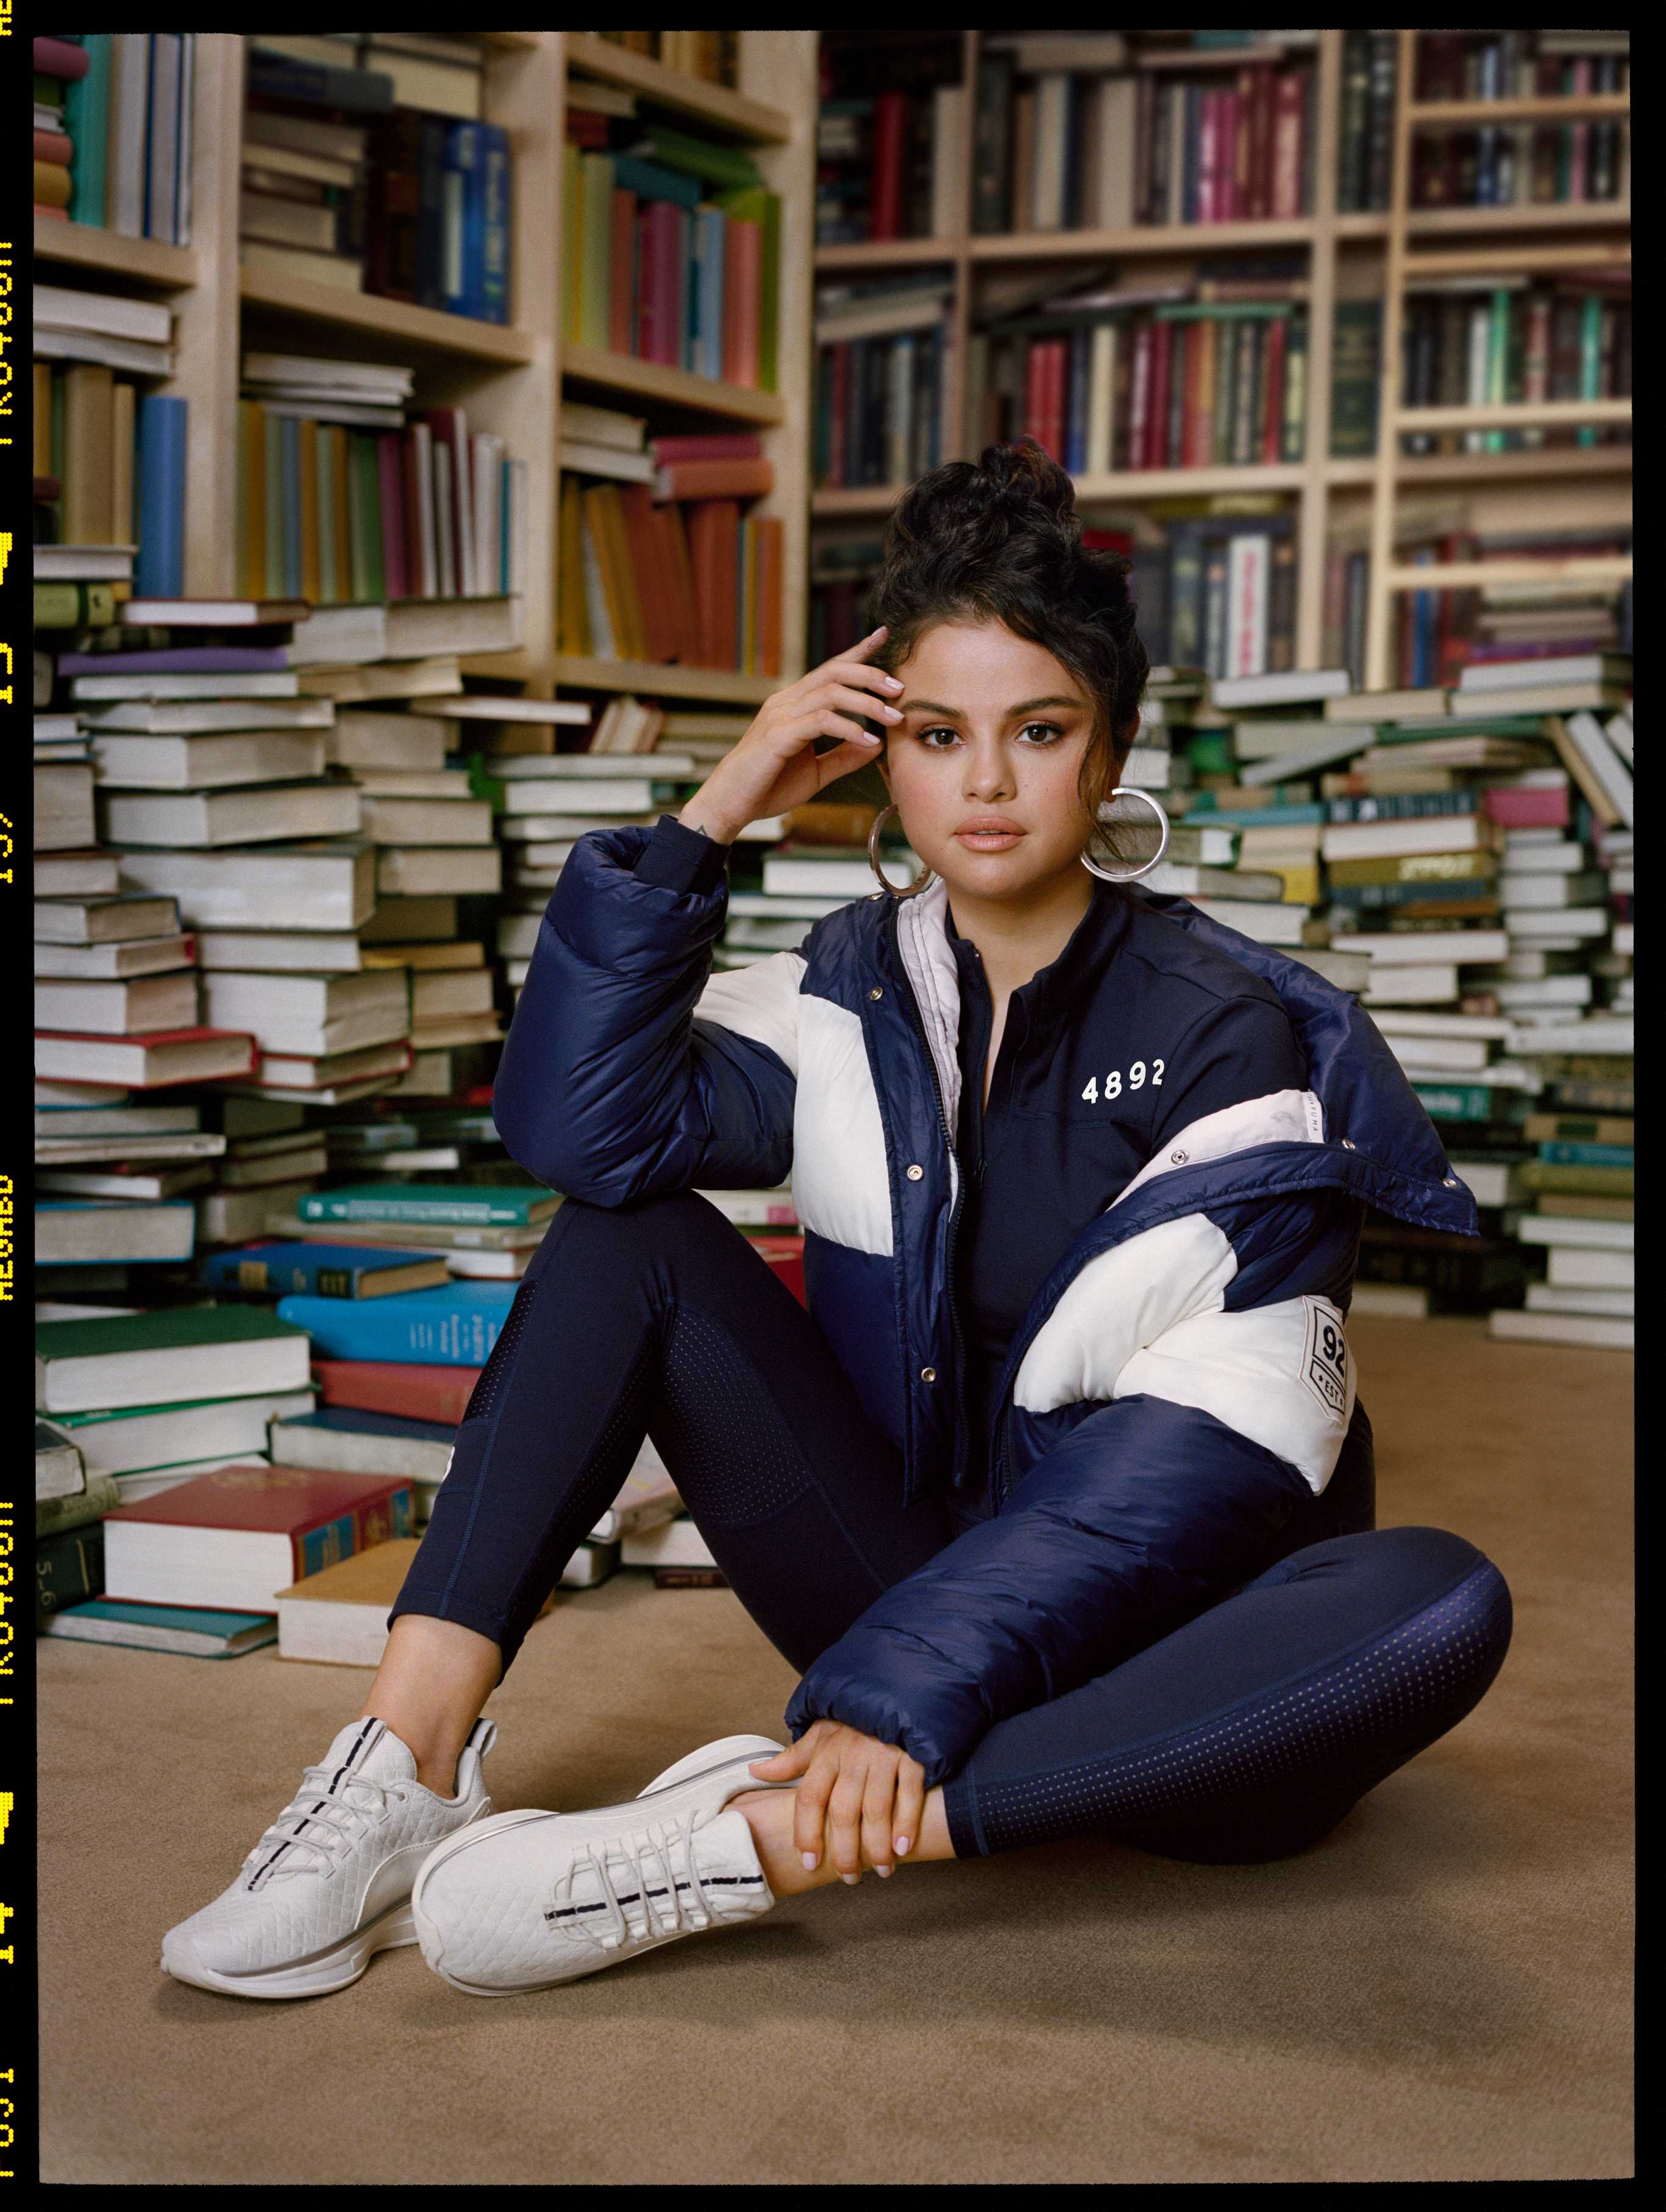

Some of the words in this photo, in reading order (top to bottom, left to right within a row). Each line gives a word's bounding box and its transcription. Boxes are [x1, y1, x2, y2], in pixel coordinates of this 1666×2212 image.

[1081, 1058, 1165, 1104] 4892
[1322, 1324, 1345, 1378] 92
[1324, 1379, 1339, 1404] EST
